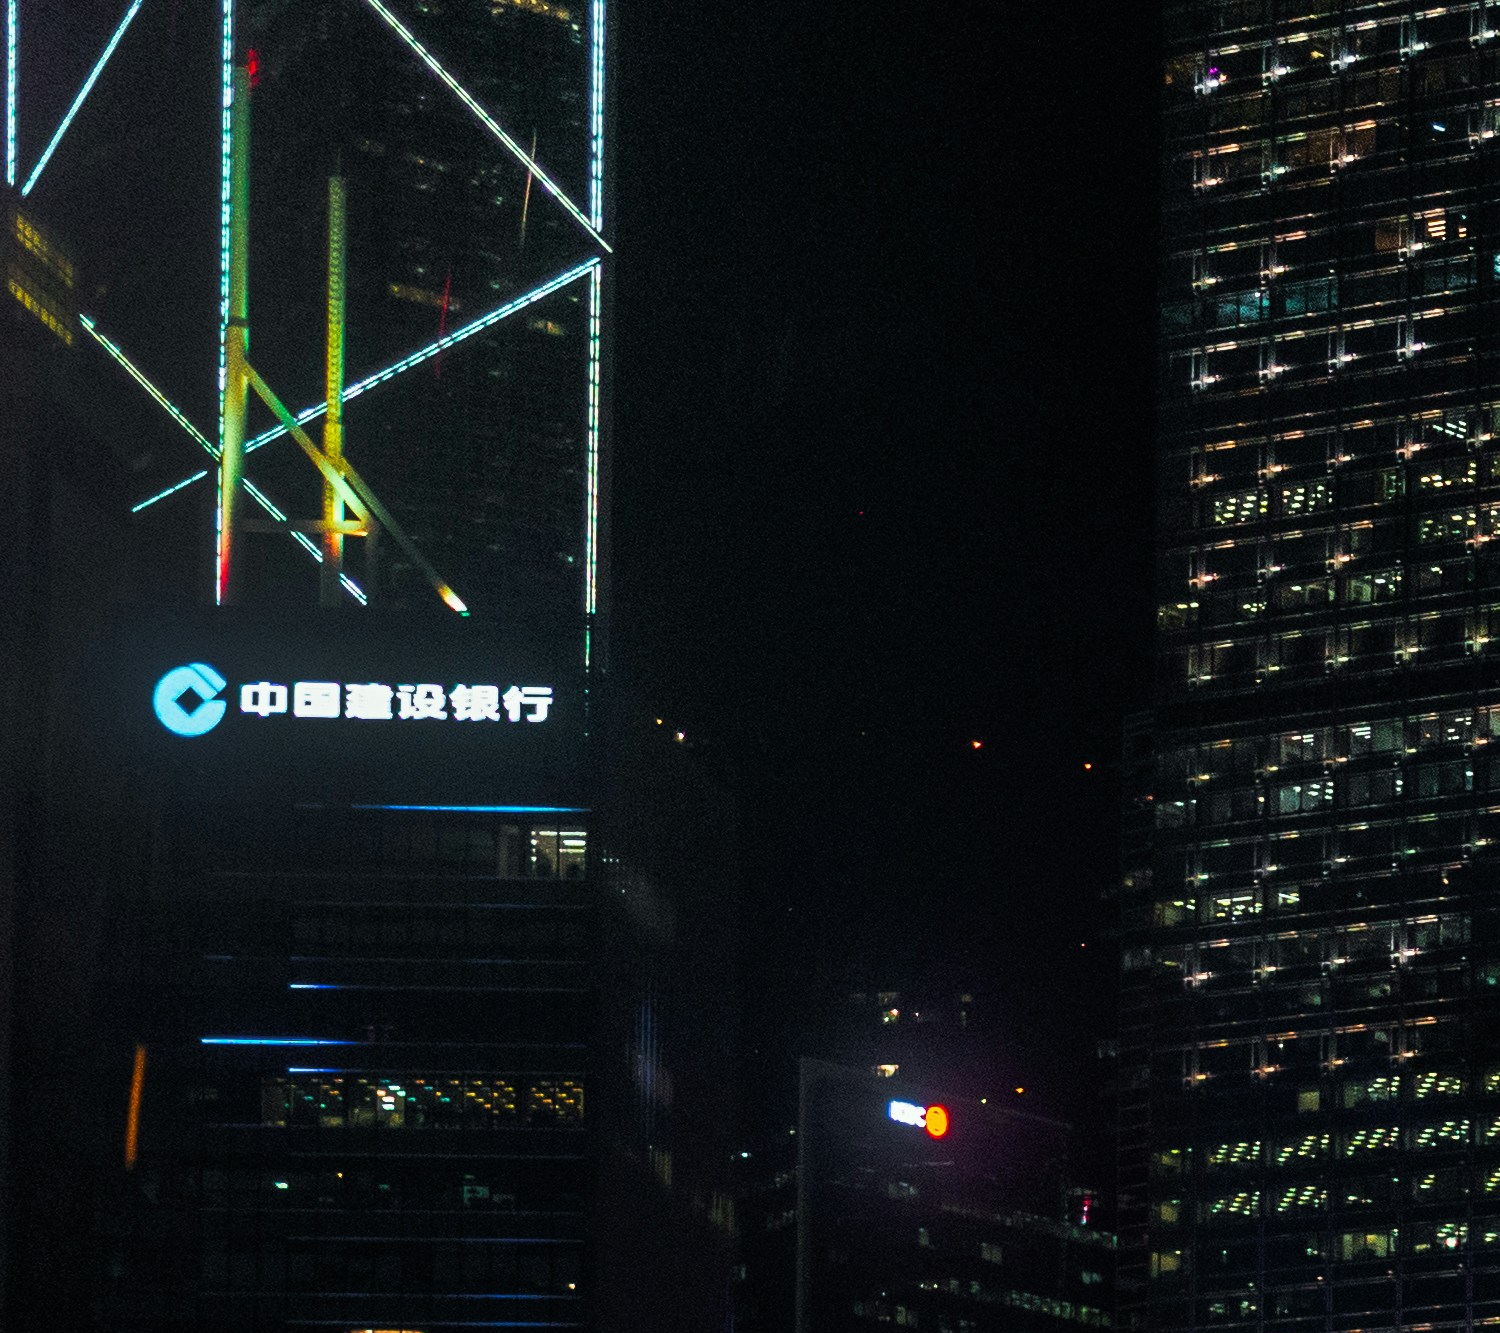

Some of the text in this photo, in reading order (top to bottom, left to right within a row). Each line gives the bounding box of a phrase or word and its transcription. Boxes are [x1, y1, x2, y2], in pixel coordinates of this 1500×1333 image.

[240, 682, 553, 722] 中国建设银行
